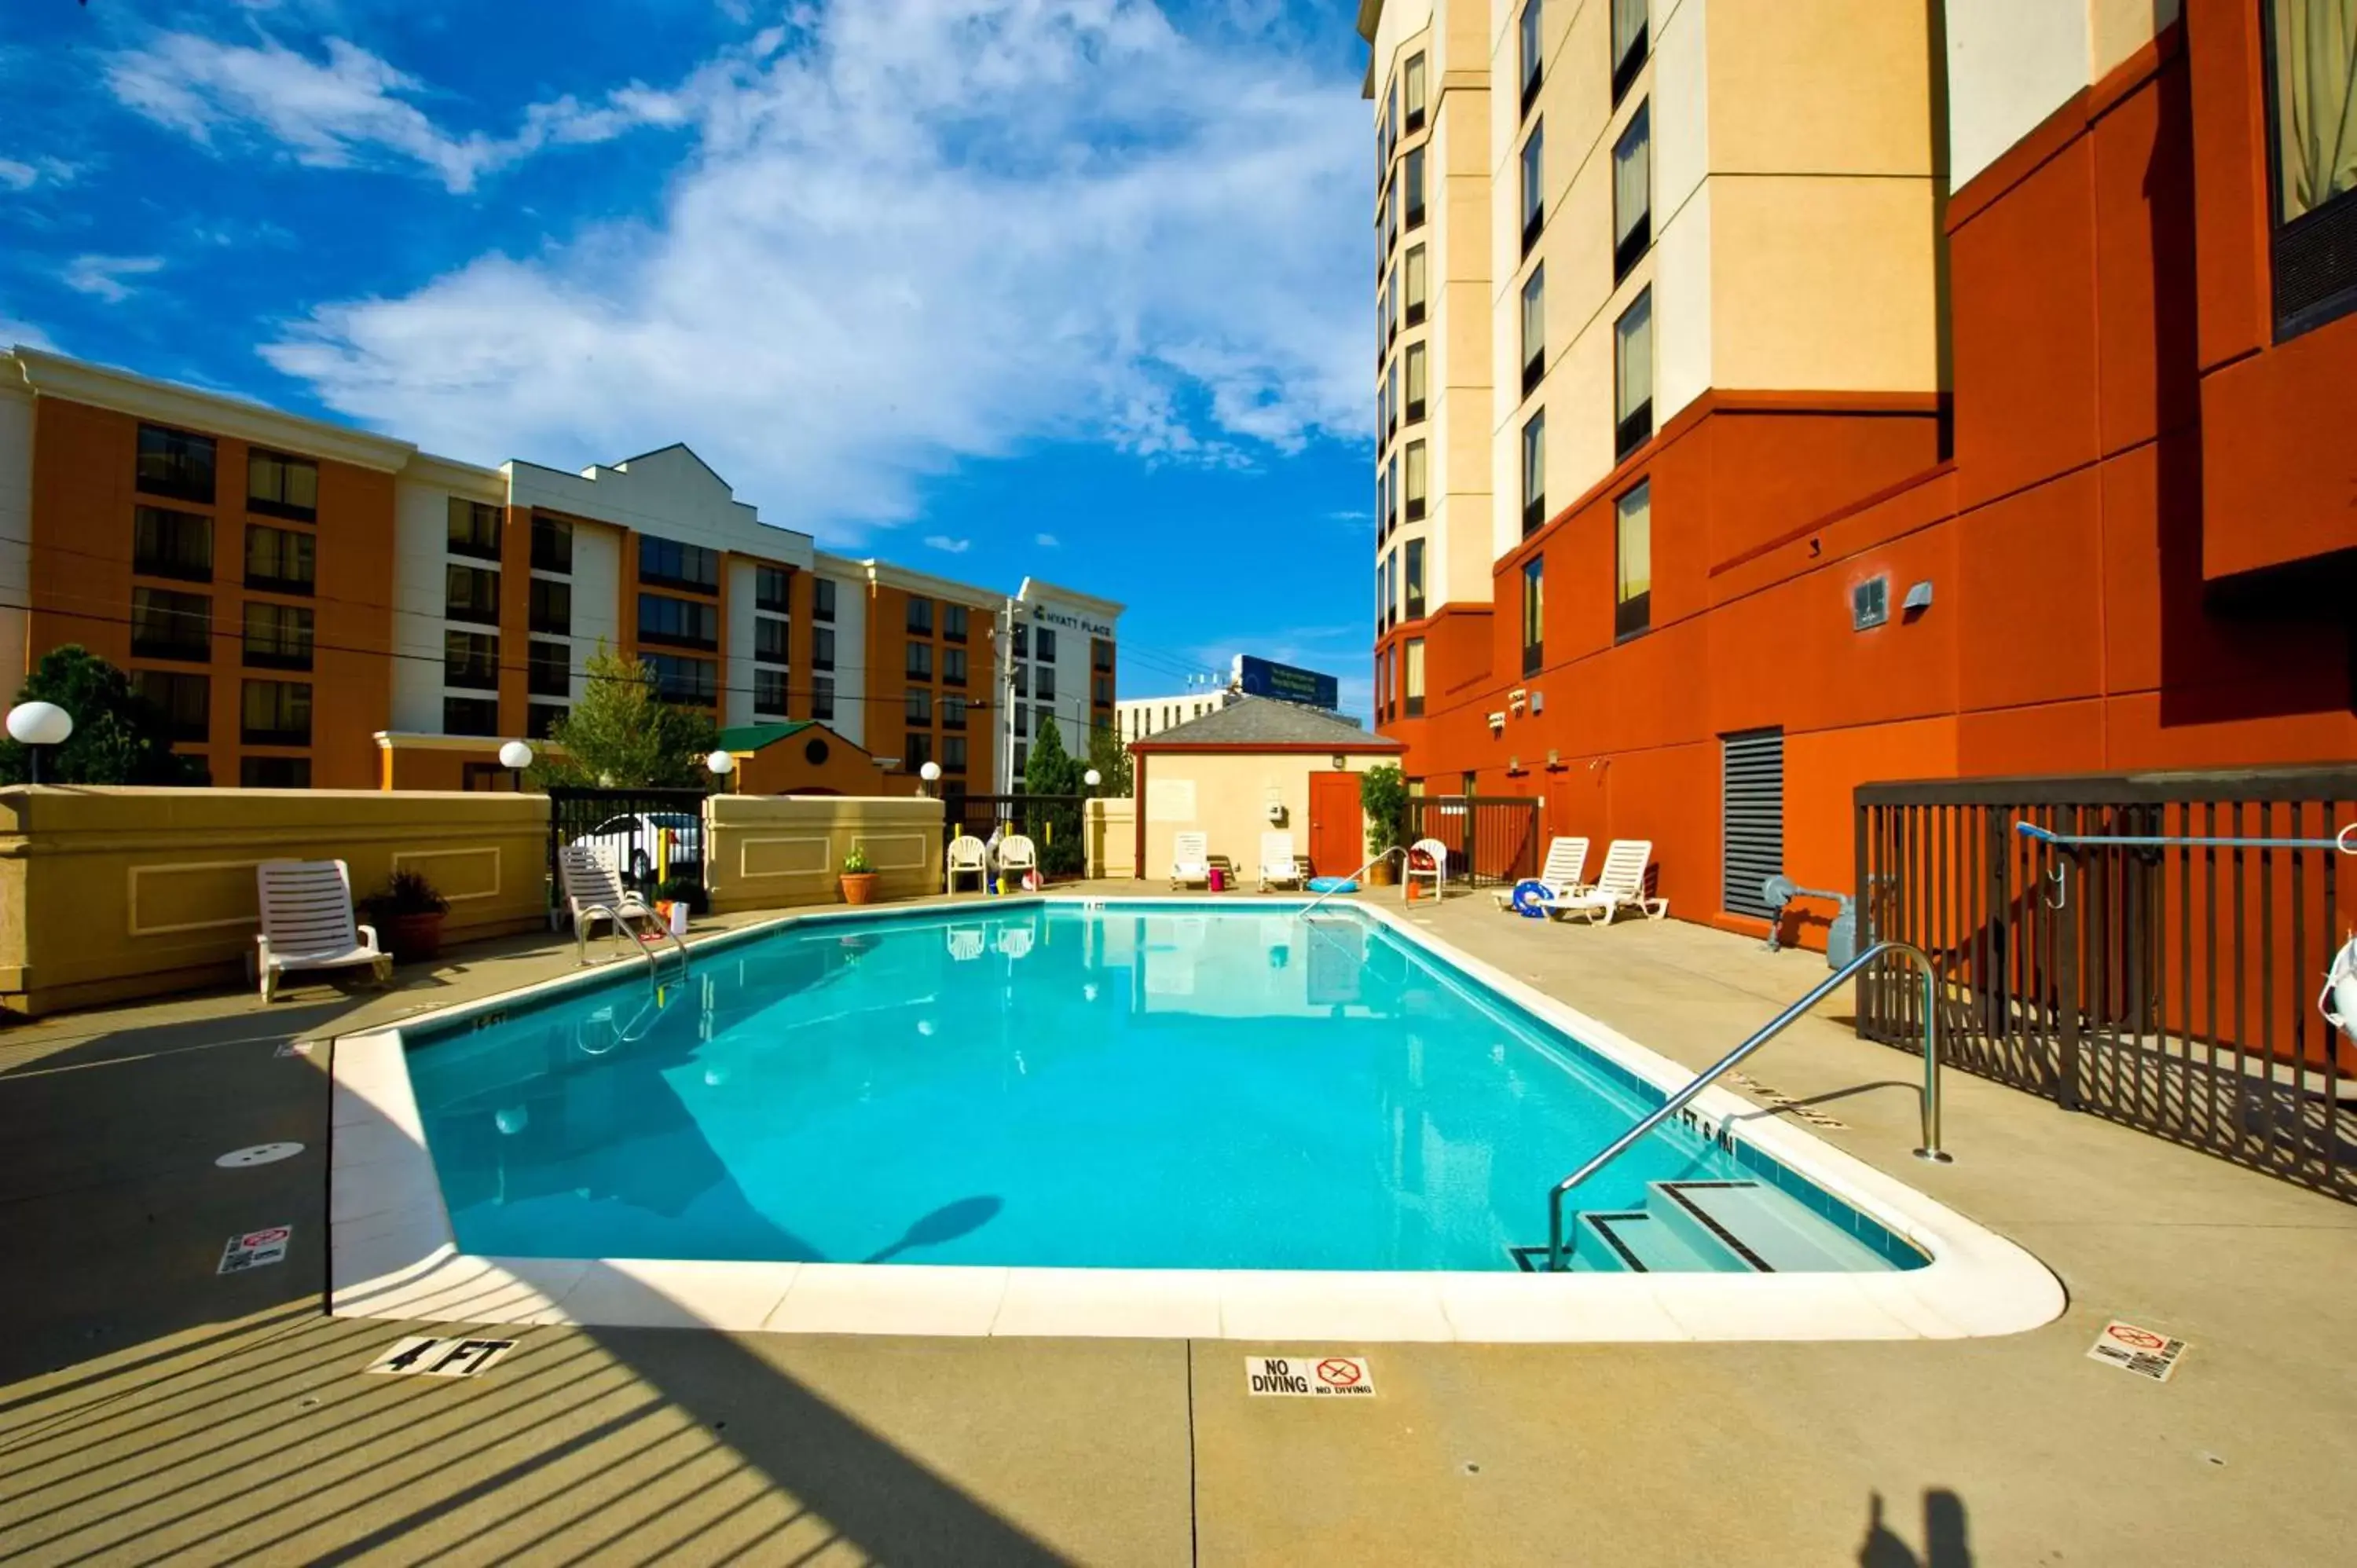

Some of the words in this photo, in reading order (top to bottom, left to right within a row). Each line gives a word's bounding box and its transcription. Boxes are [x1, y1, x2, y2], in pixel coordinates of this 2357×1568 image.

[1047, 613, 1077, 629] HYATT
[1082, 621, 1111, 637] PLACE
[1682, 1106, 1698, 1131] FT
[387, 1339, 438, 1371] 4
[428, 1340, 515, 1374] FT
[1265, 1359, 1288, 1376] NO
[1252, 1376, 1308, 1393] DIVING
[1314, 1386, 1332, 1394] NO
[1336, 1385, 1373, 1394] DIVING
